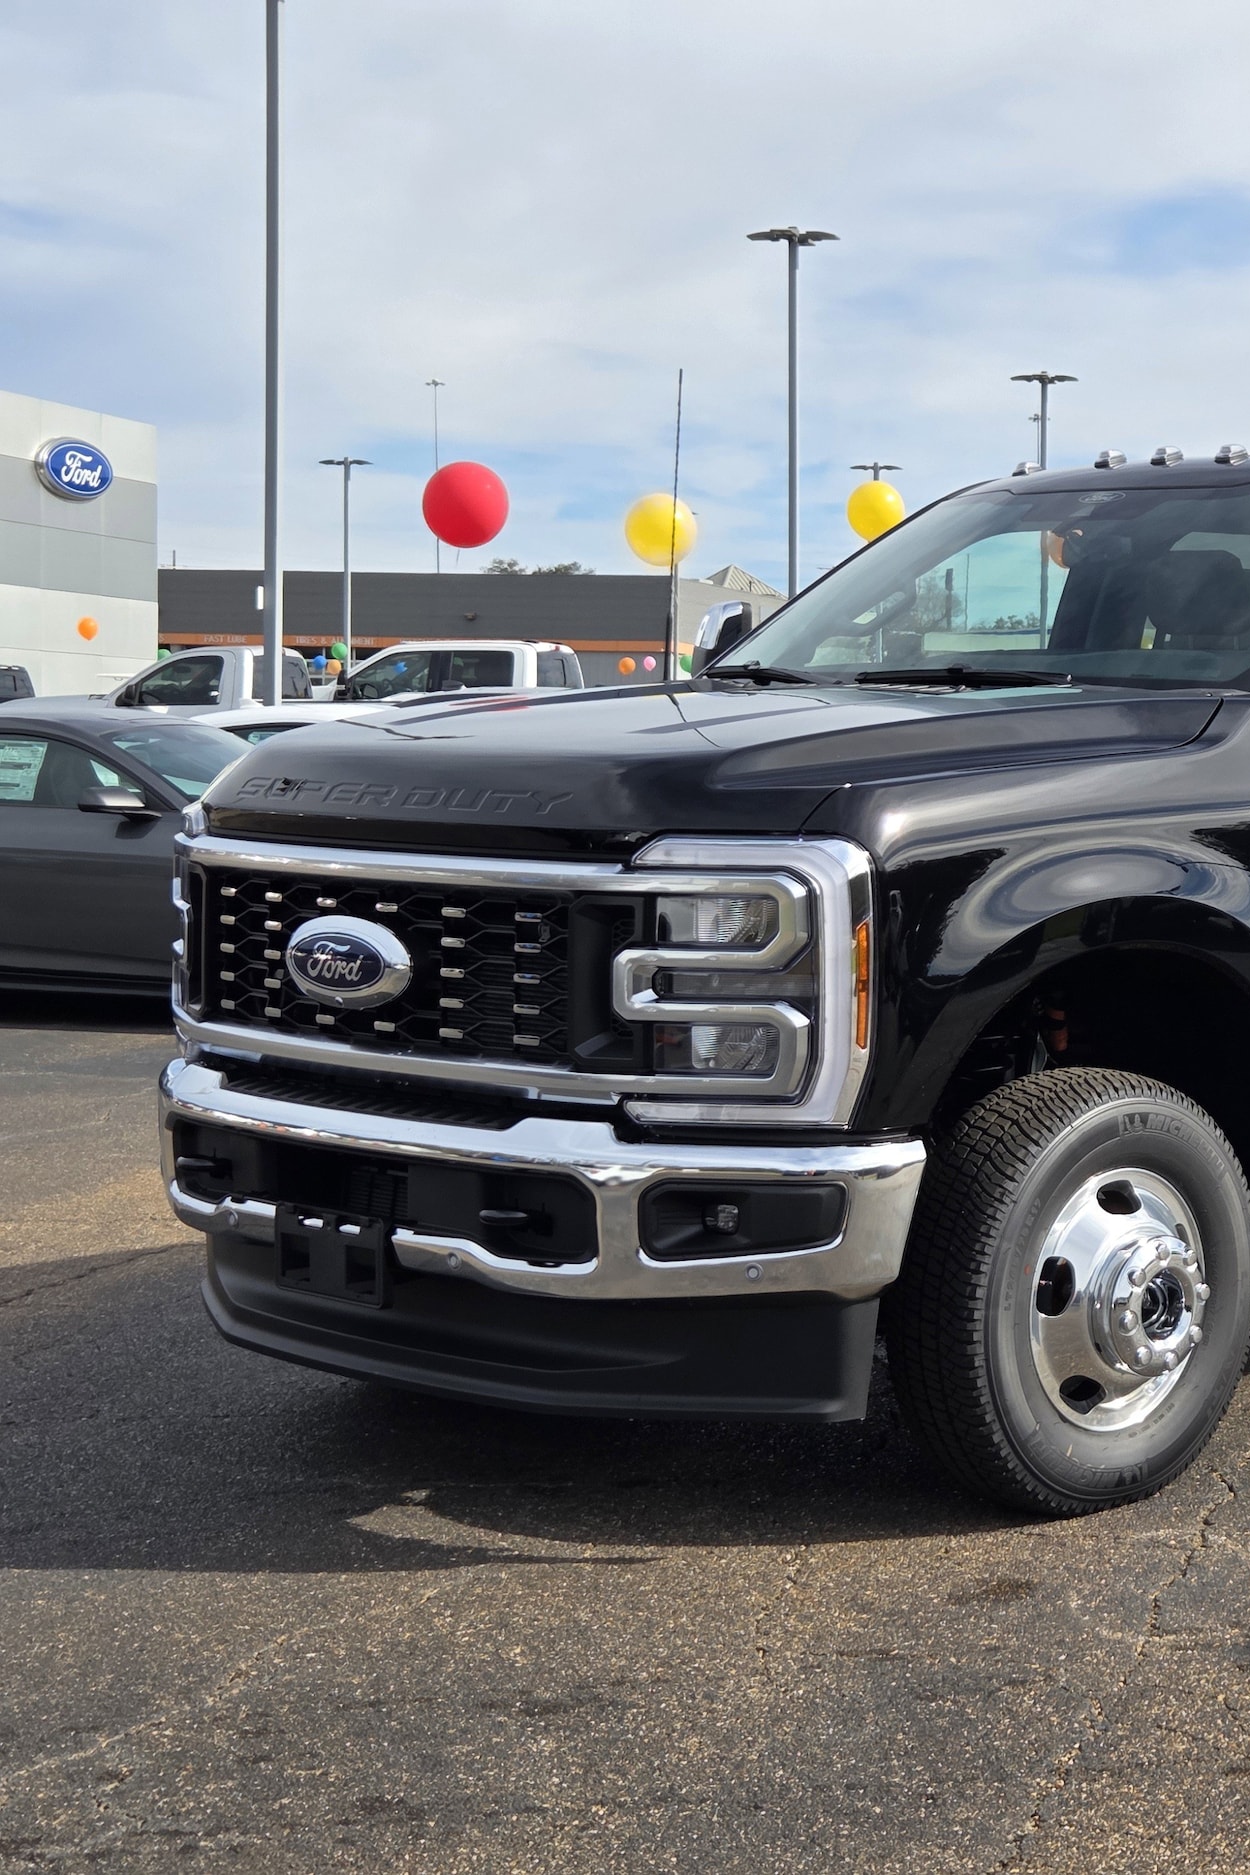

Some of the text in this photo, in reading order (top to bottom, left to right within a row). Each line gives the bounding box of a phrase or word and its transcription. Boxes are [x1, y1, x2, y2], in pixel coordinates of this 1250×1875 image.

[61, 450, 102, 487] Ford
[203, 634, 247, 643] FAST LUBE
[236, 776, 575, 815] SUPER DUTY
[306, 940, 365, 981] Ford
[1145, 1112, 1226, 1174] MICHELIN
